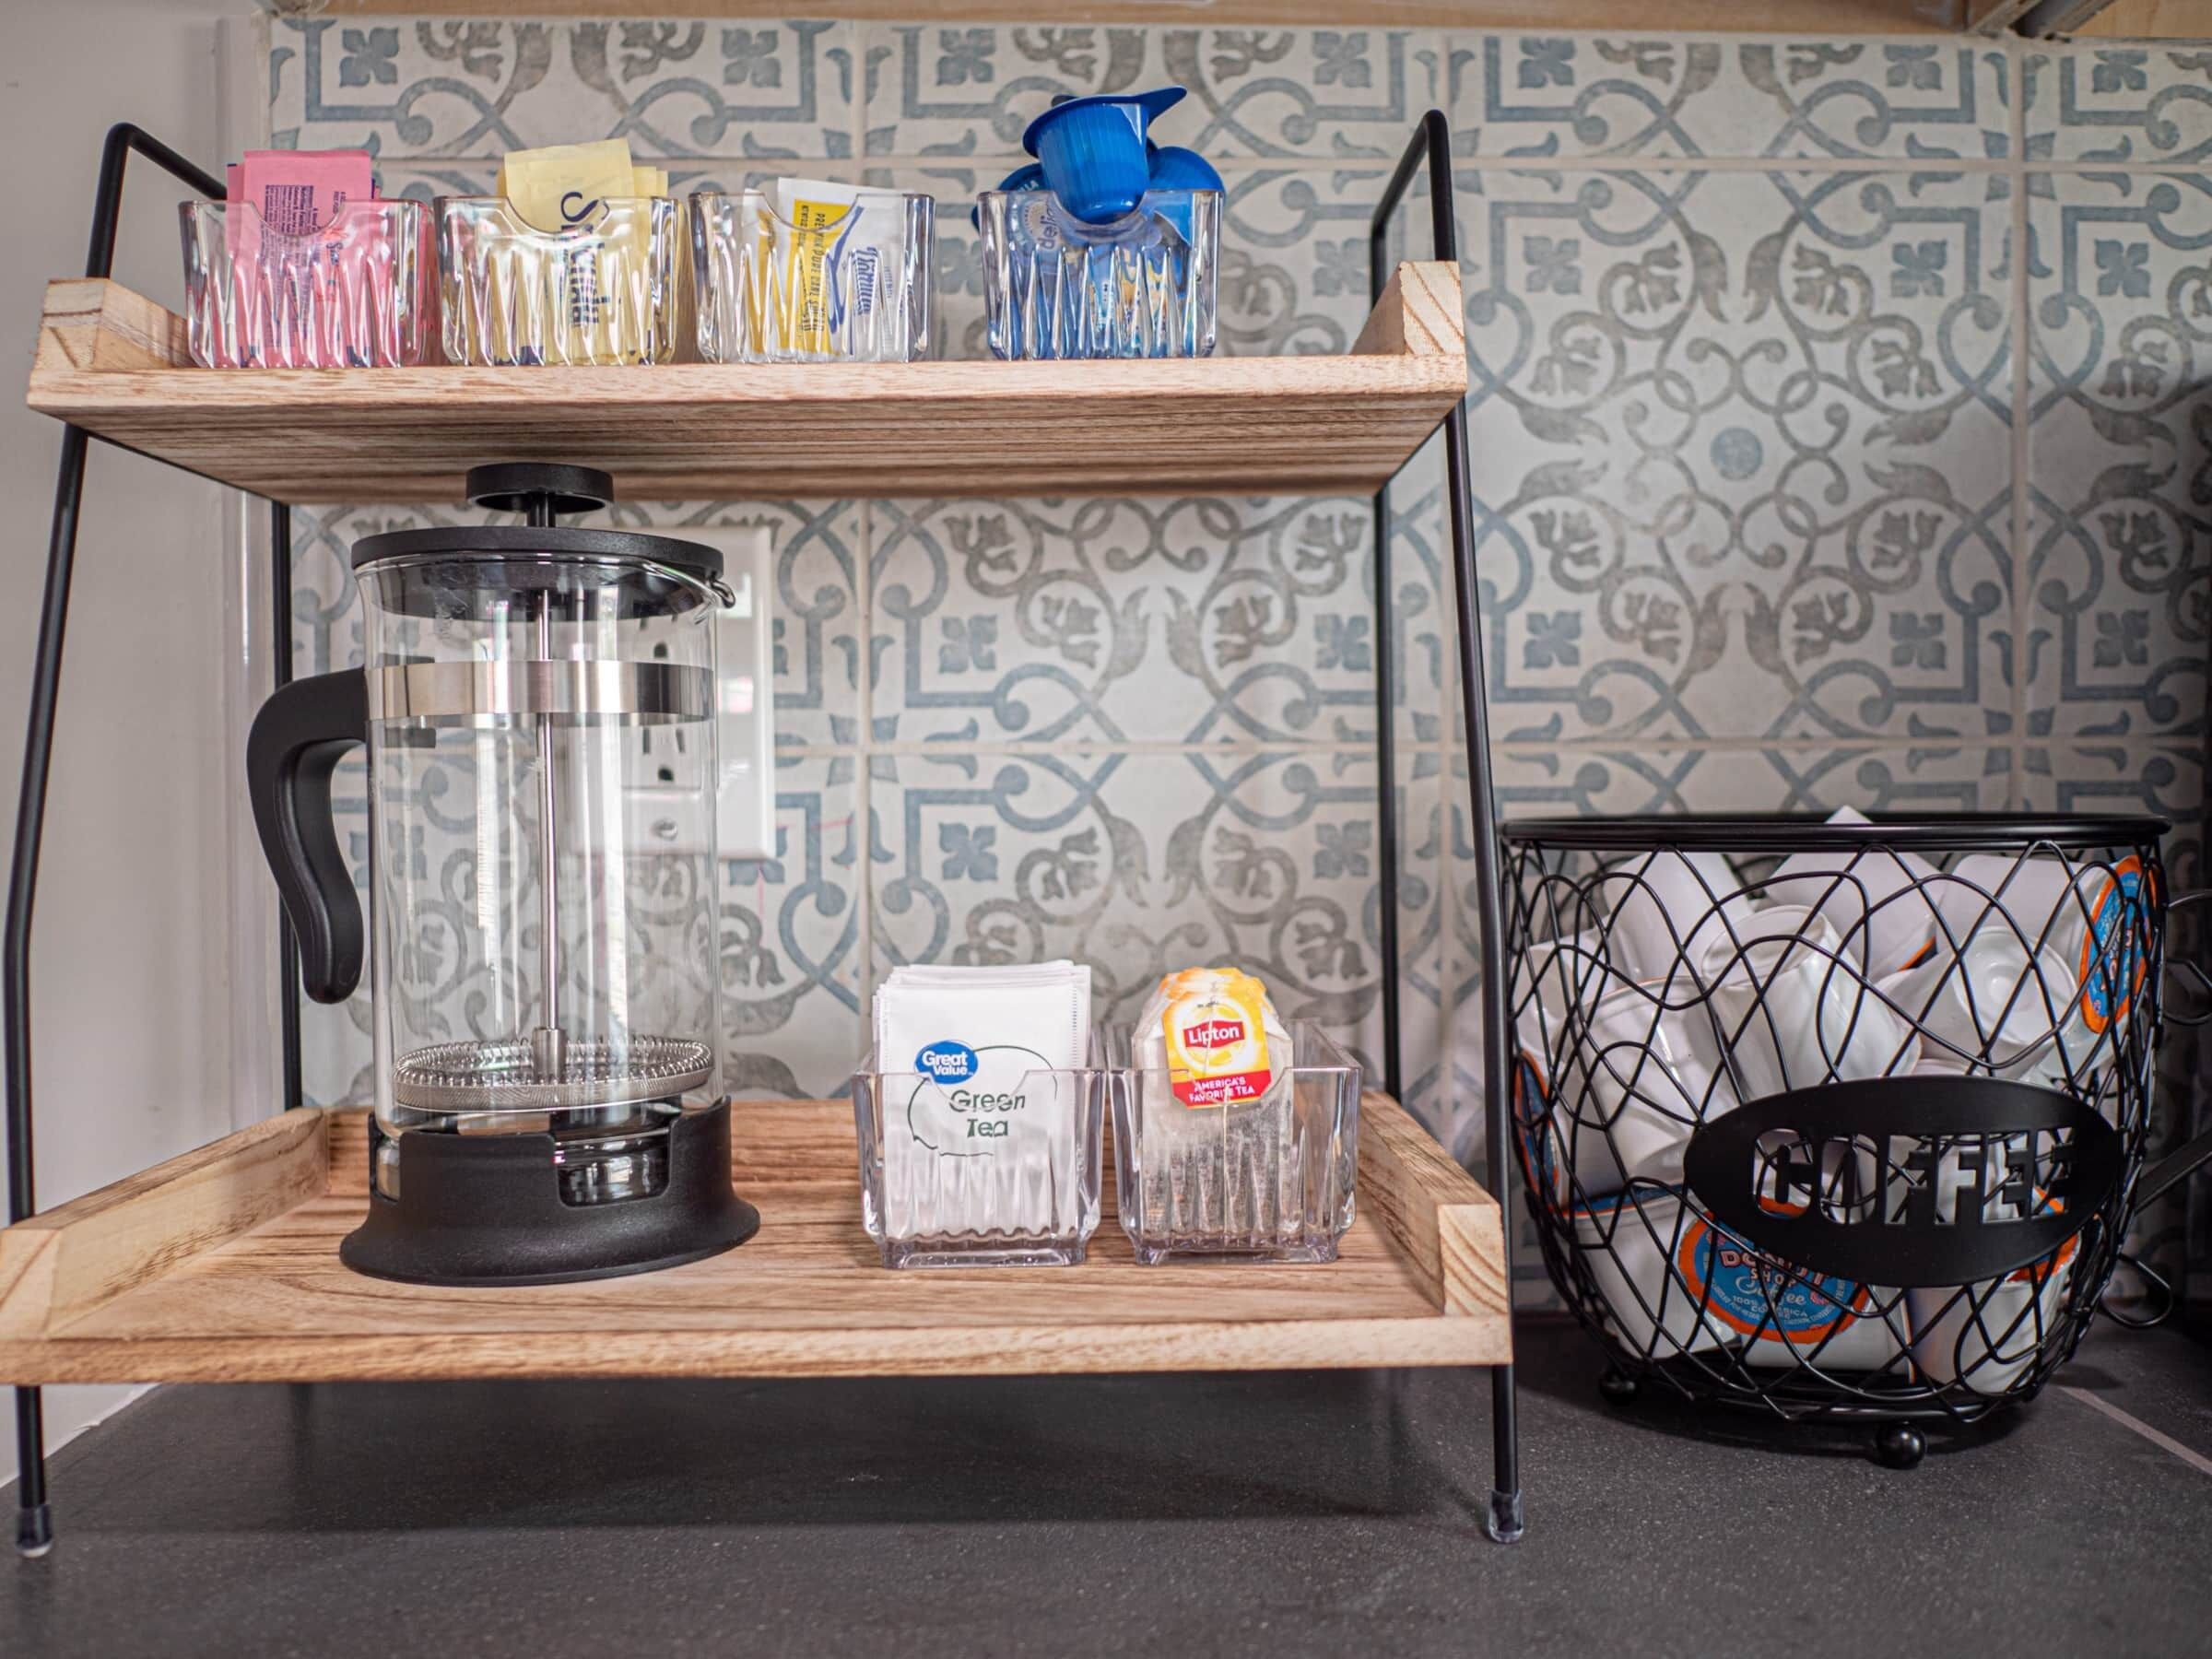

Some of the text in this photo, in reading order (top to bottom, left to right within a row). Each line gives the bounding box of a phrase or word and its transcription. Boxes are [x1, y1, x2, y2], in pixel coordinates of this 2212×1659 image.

[1187, 1026, 1240, 1045] Lipton
[922, 1050, 968, 1067] Great
[933, 1065, 968, 1076] Value
[1188, 1086, 1256, 1103] FAVORITE TEA
[1194, 1077, 1246, 1093] AMERICA'S
[948, 1089, 1026, 1112] Green
[966, 1118, 1009, 1138] Tea
[1753, 1127, 2074, 1225] COFFEE
[1750, 1267, 1797, 1288] SHOP
[1735, 1276, 1807, 1306] Coee
